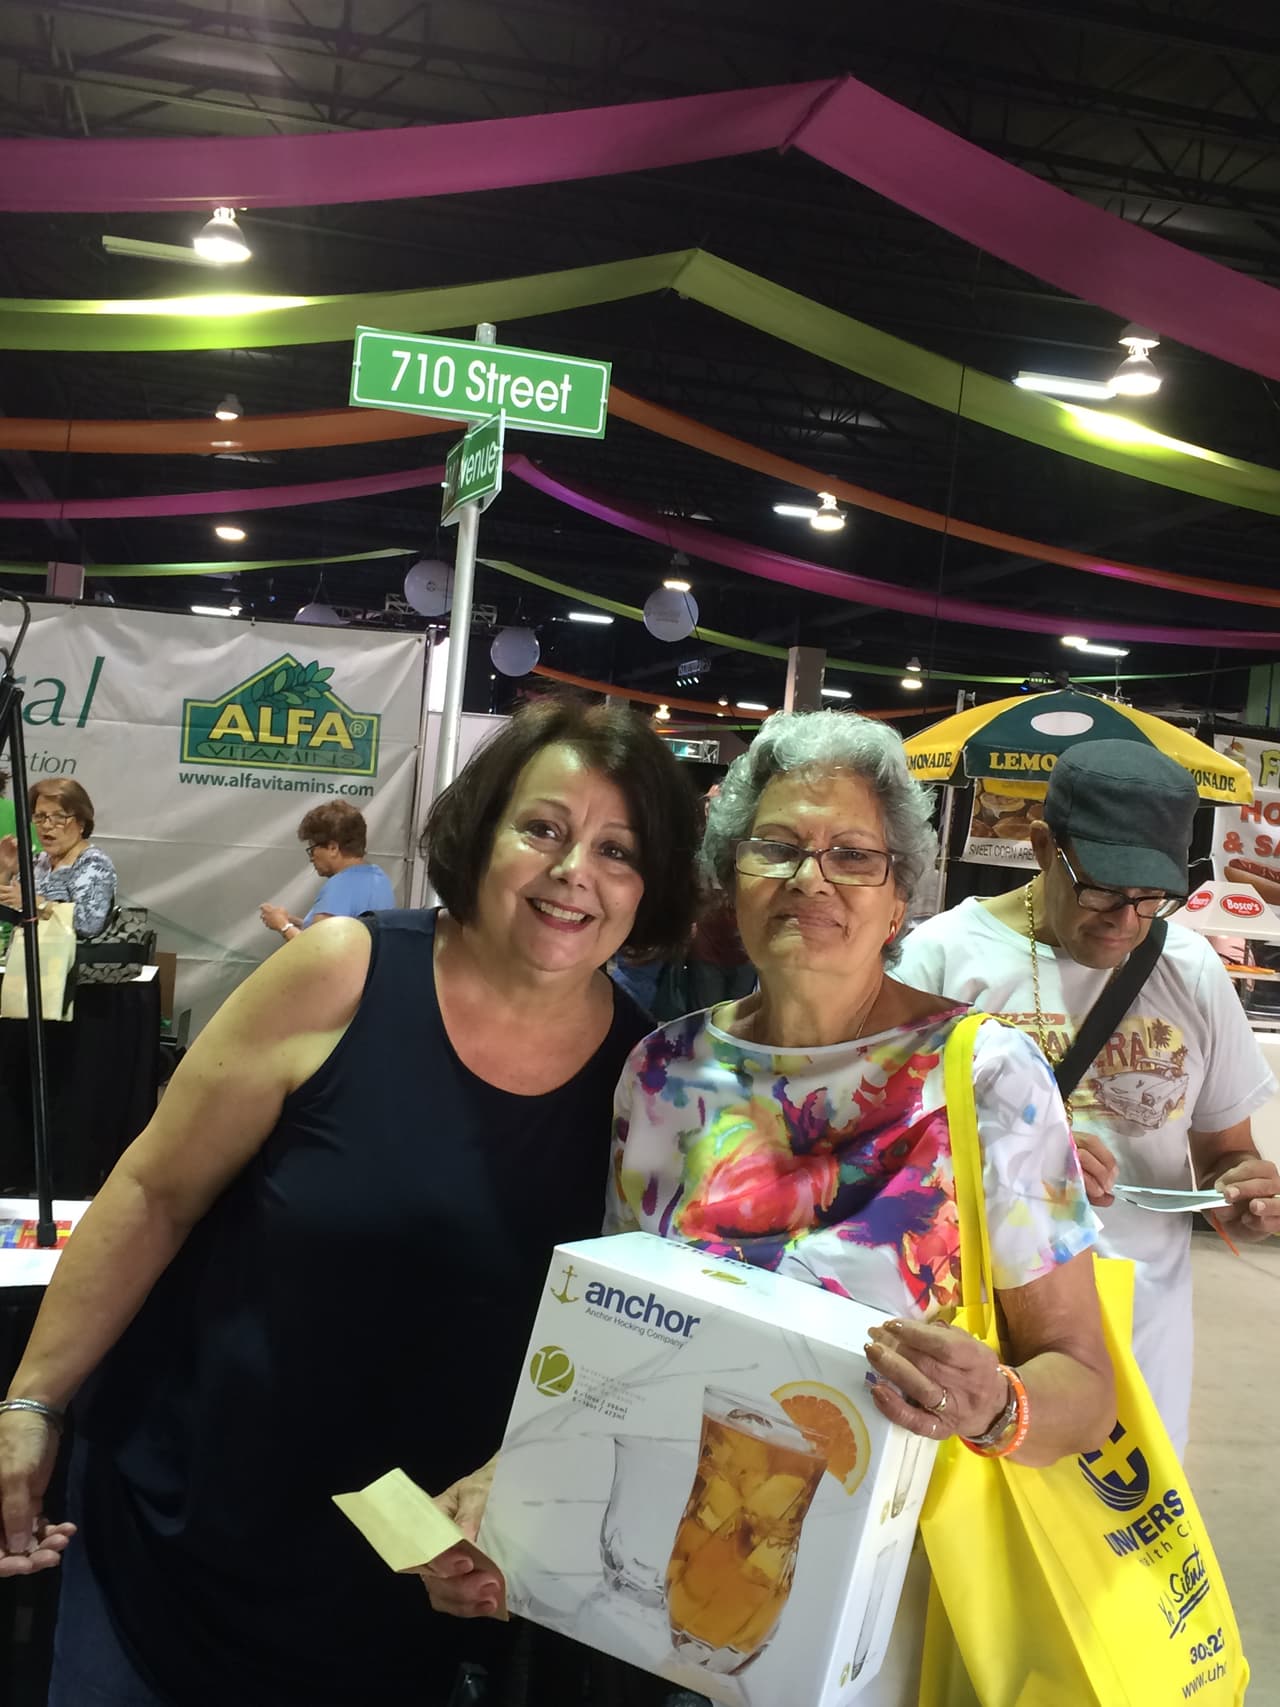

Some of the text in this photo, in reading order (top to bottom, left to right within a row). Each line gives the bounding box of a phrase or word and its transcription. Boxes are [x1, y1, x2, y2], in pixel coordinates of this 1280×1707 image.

[391, 350, 572, 414] 710 Street
[16, 655, 106, 728] al
[208, 703, 354, 750] ALFA
[207, 743, 357, 769] VITAMINS
[1258, 749, 1280, 787] F
[179, 771, 375, 797] www.alfavitamins.com
[1223, 832, 1245, 855] &
[1227, 899, 1260, 911] Bosco's
[585, 1281, 701, 1338] anchor
[585, 1307, 686, 1350] Anchor Hocking Company
[534, 1350, 573, 1395] 12
[1182, 1661, 1227, 1699] www.uh
